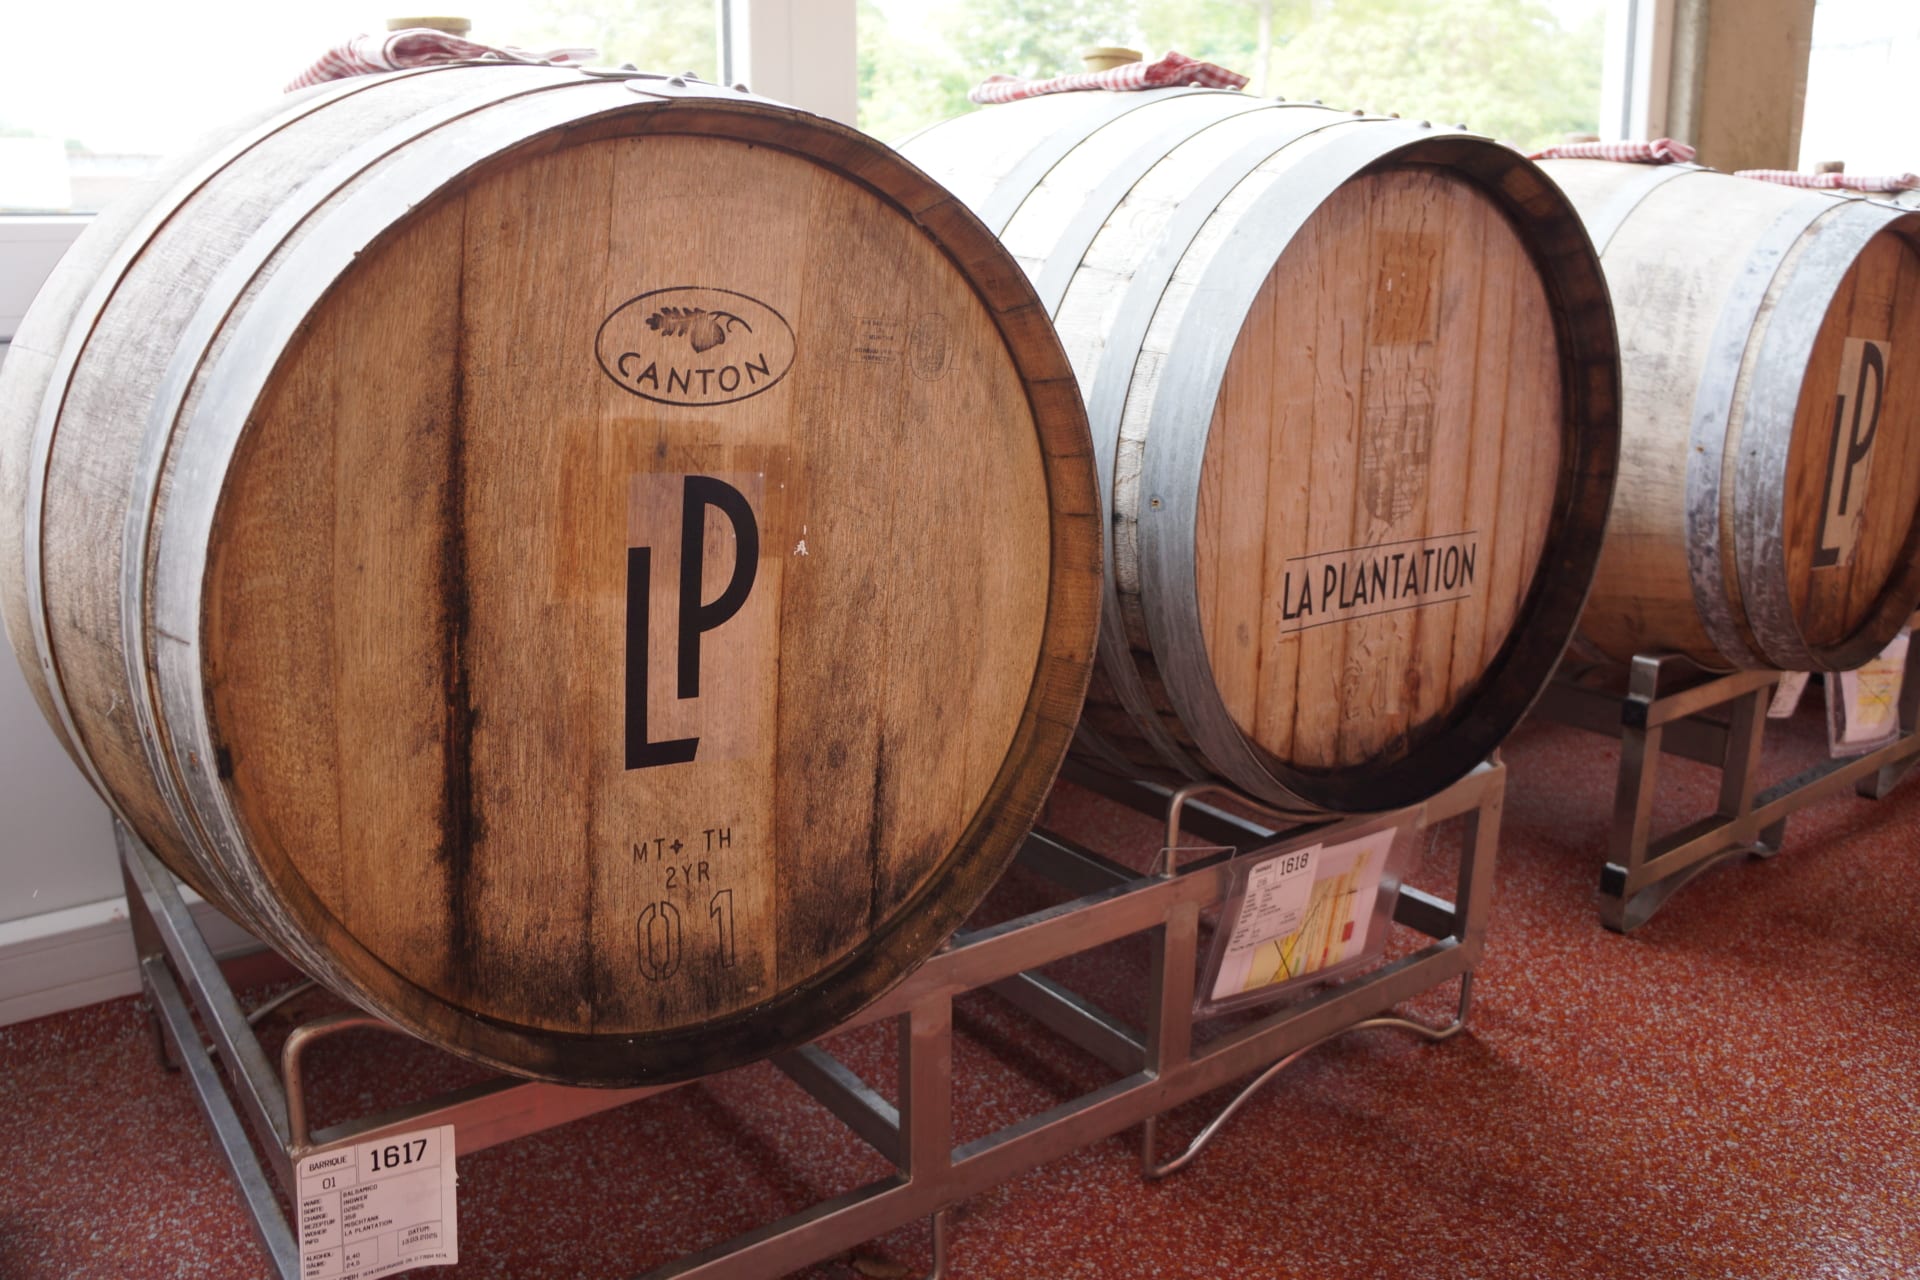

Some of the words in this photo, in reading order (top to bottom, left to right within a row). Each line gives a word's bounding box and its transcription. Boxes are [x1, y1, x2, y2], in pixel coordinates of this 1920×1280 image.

[618, 352, 771, 396] CANTON
[1812, 340, 1885, 567] LP
[1282, 569, 1313, 620] LA
[1321, 542, 1477, 613] PLANTATION
[624, 474, 760, 771] LP
[702, 827, 732, 852] TH
[665, 860, 711, 890] 2YR
[1279, 852, 1310, 876] 1618
[636, 888, 735, 982] 01
[309, 1156, 348, 1172] BARRIQUE
[370, 1138, 428, 1172] 1617
[322, 1176, 337, 1190] 01
[344, 1228, 353, 1237] LA
[354, 1219, 393, 1234] PLANTATION
